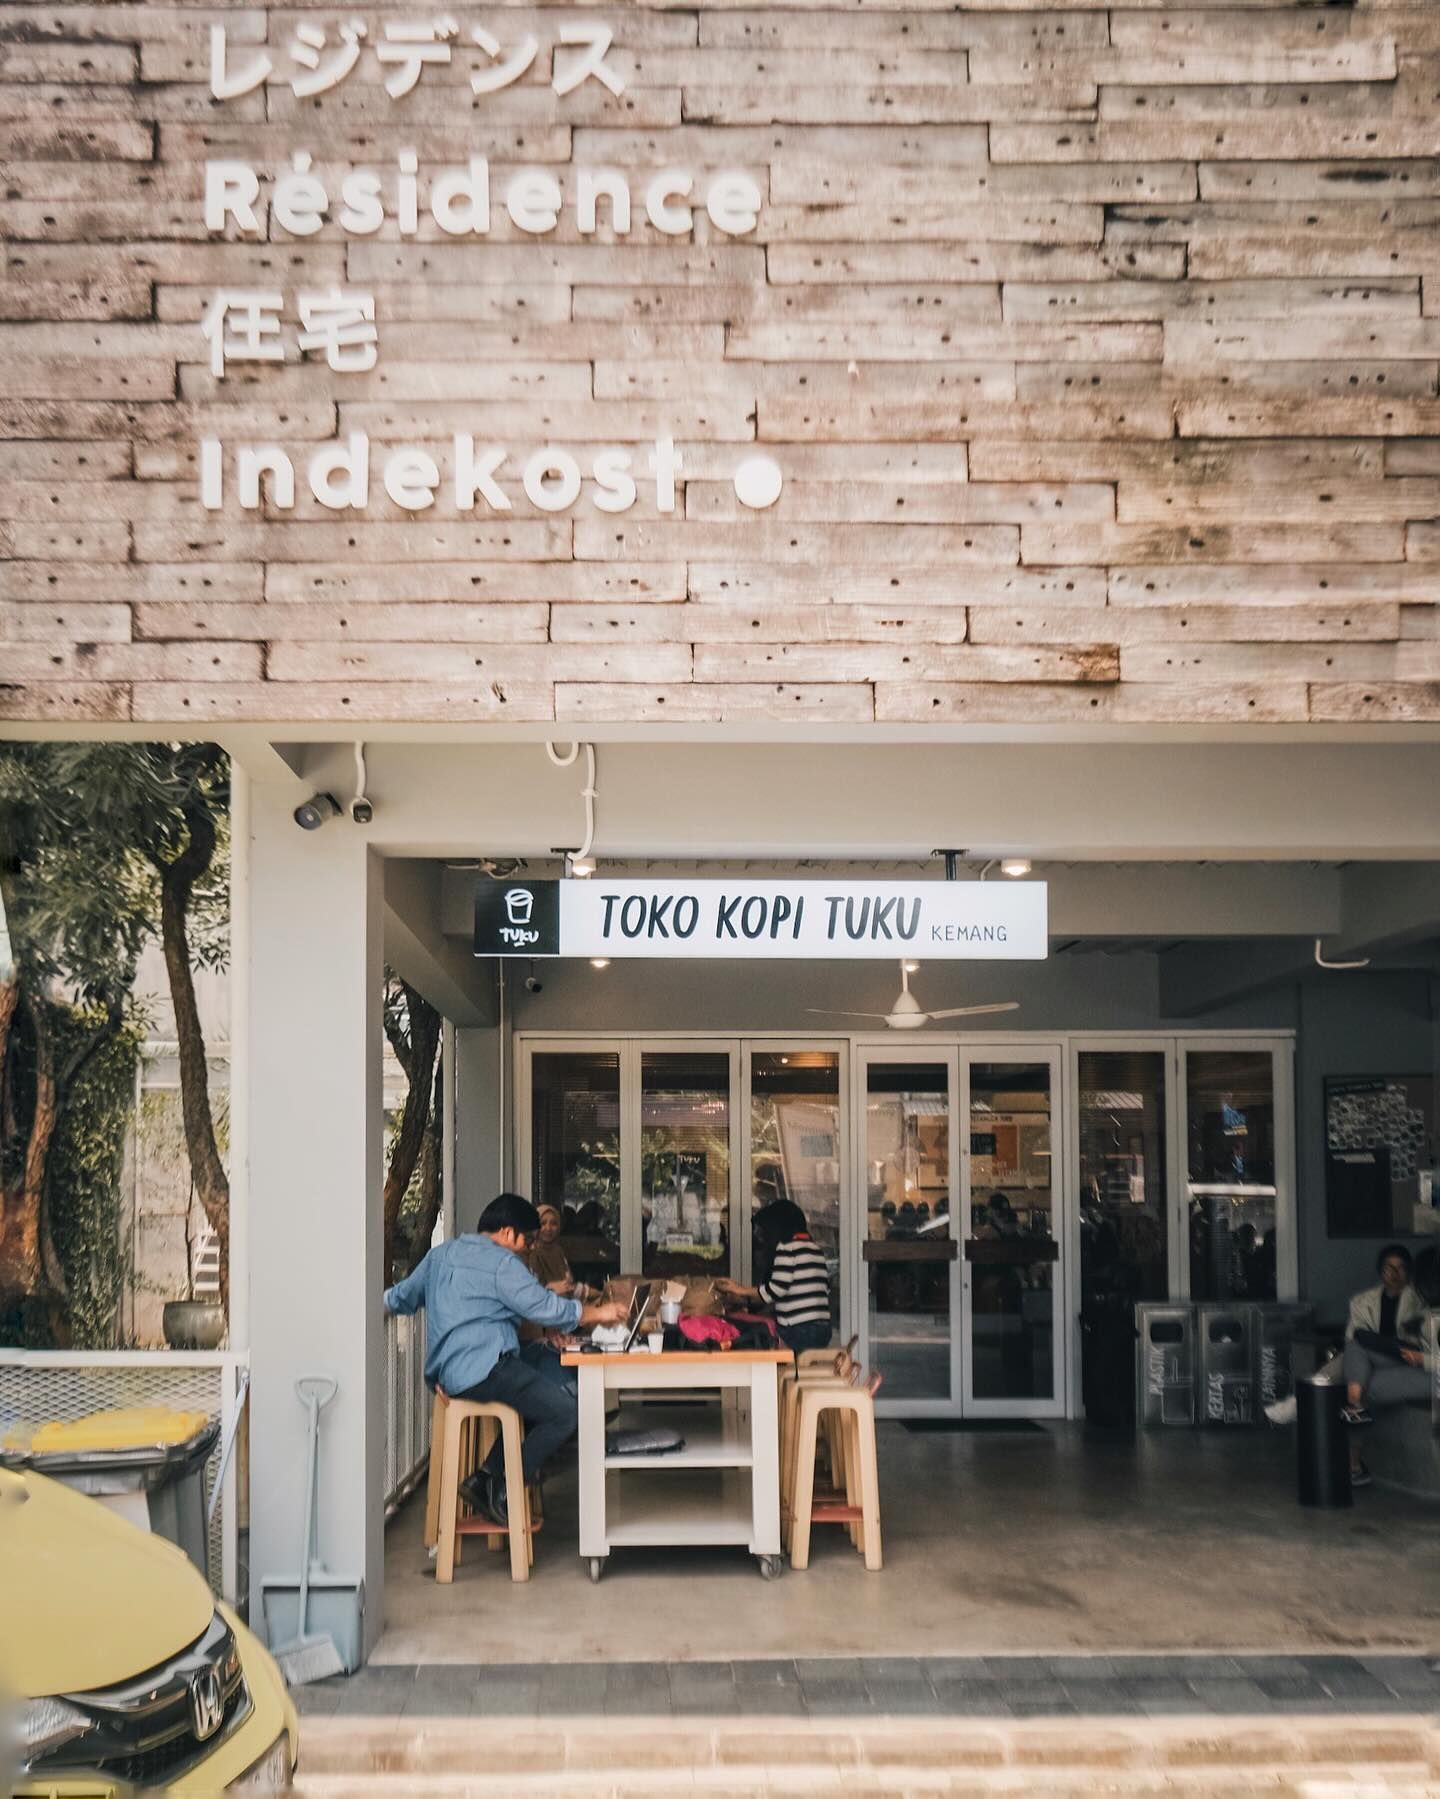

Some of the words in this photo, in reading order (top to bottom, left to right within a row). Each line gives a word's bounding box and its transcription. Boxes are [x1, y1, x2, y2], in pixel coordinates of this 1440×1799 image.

[210, 16, 626, 99] レジデンス
[204, 150, 763, 235] Résidence
[200, 285, 378, 378] 住宅
[203, 433, 684, 512] Indekost
[499, 927, 539, 946] TUKU
[600, 895, 699, 939] TOKO
[715, 895, 805, 940] KOPI
[825, 896, 922, 940] TUKU
[931, 925, 1008, 942] KEMANG
[1208, 1372, 1224, 1420] KERTAS
